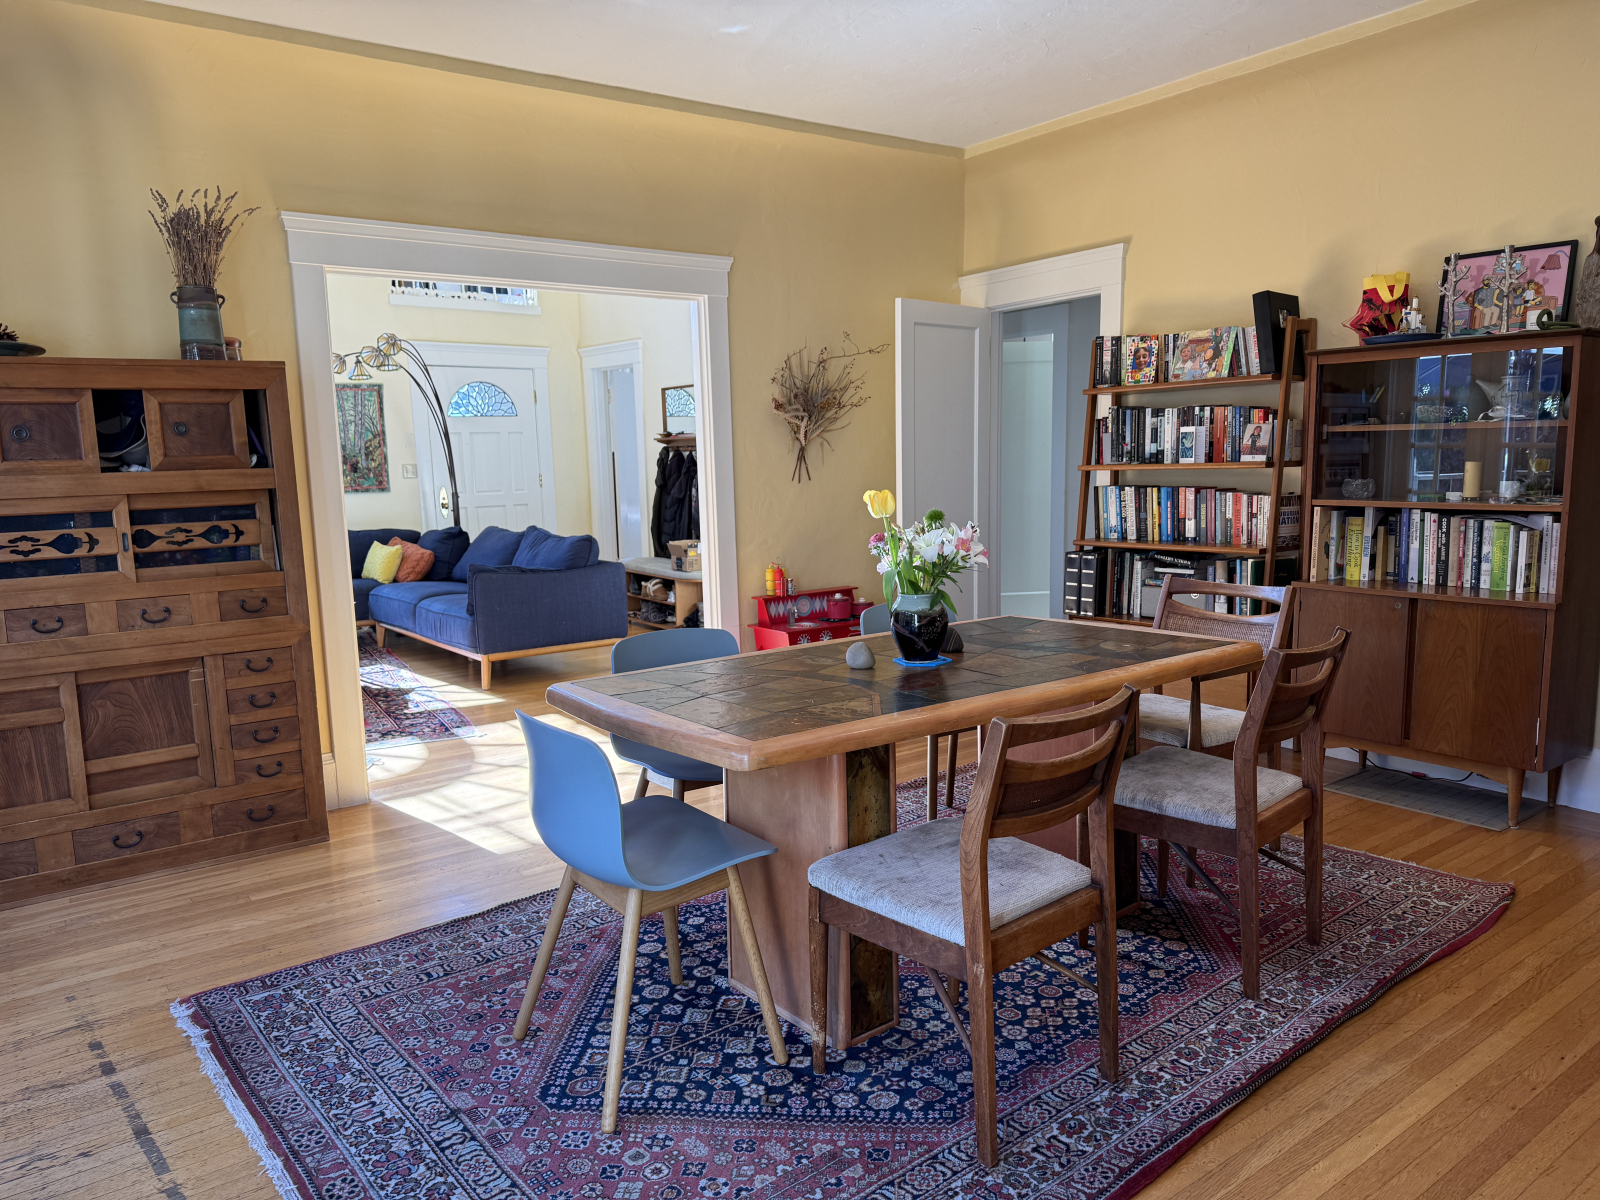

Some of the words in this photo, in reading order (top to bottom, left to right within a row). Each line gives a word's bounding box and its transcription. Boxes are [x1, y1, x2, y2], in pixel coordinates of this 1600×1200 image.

[1131, 372, 1148, 380] 2026
[1346, 528, 1355, 567] Everything
[1493, 540, 1503, 573] Vegetarian
